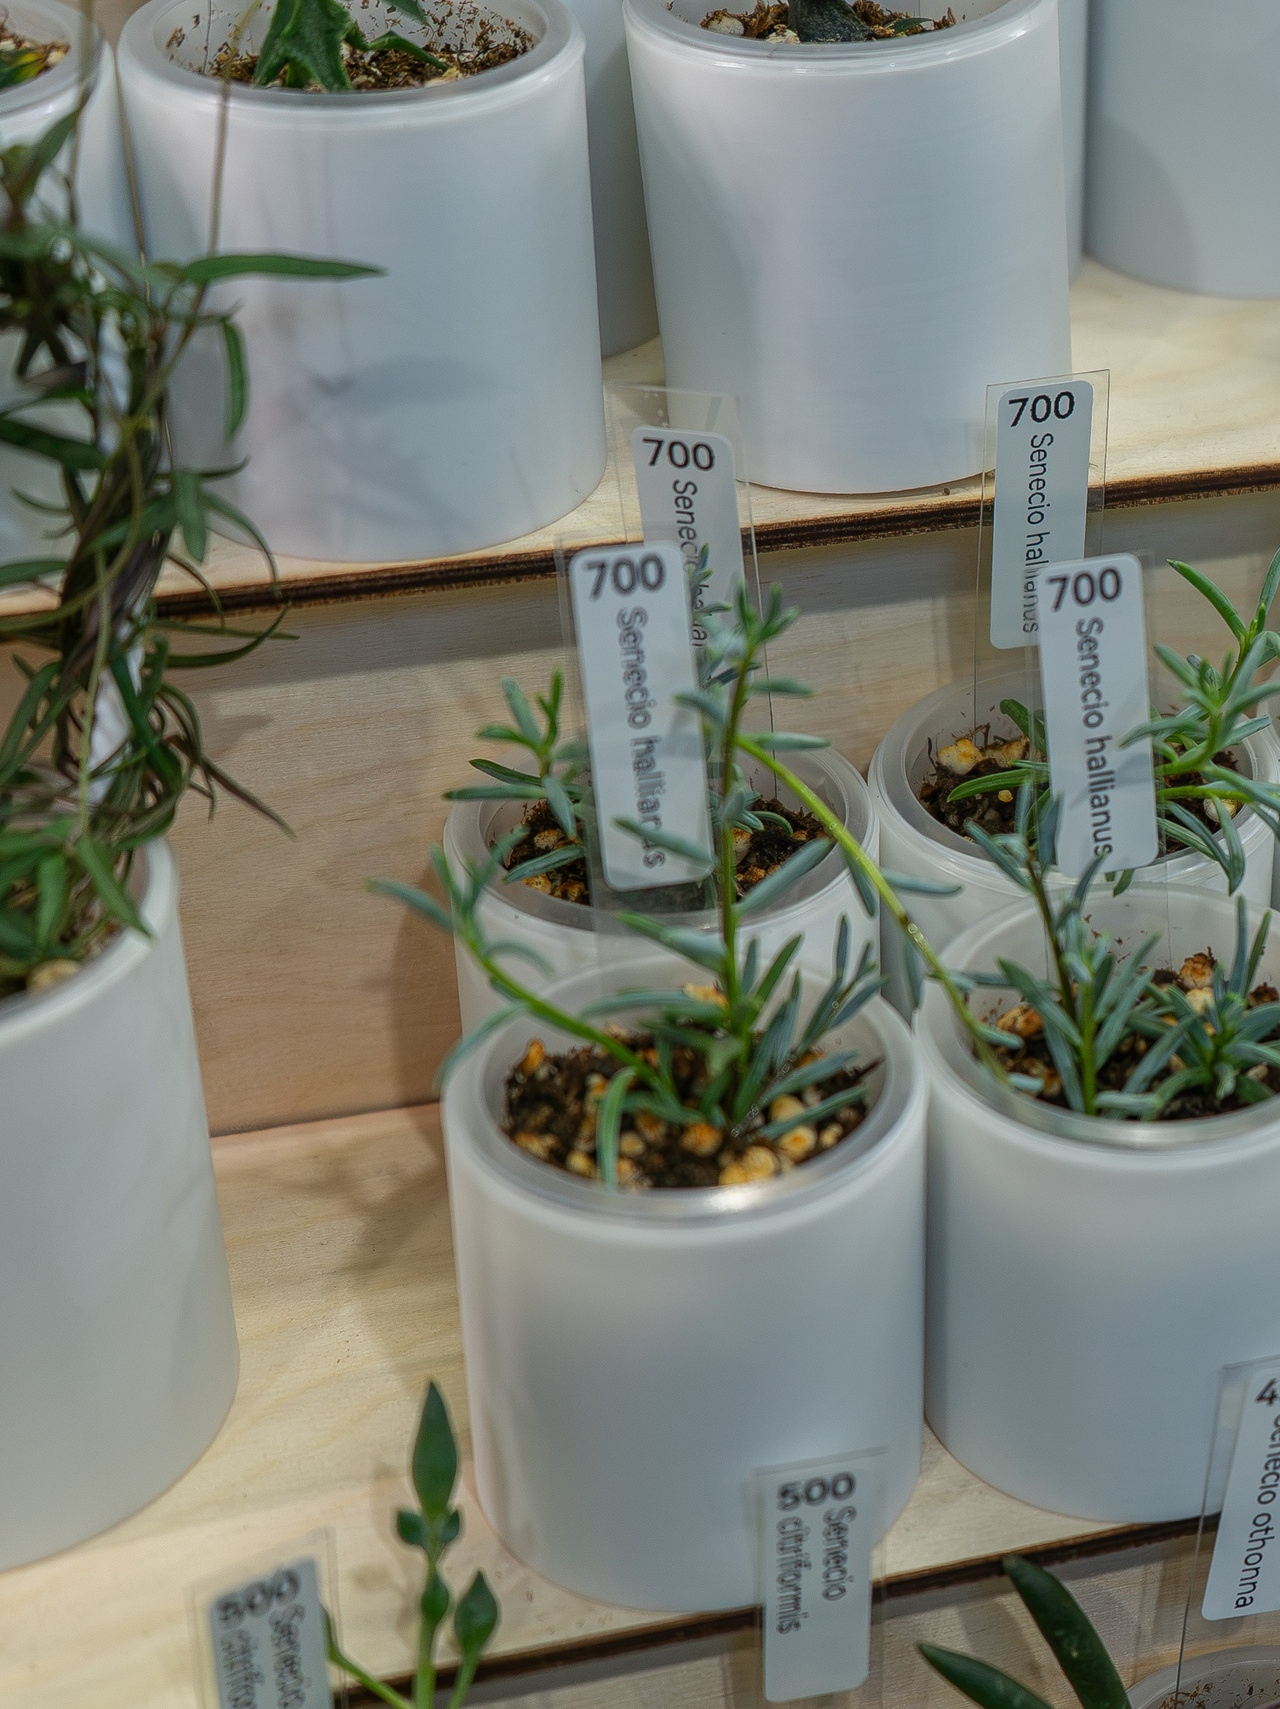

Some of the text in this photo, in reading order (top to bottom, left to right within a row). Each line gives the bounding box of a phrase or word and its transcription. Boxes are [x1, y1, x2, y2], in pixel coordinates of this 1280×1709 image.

[1009, 391, 1075, 427] 700
[642, 436, 715, 471] 700
[1027, 433, 1054, 525] Senecio
[585, 554, 665, 600] 700
[1047, 566, 1122, 612] 700
[616, 606, 666, 869] Senecio hallians
[1076, 617, 1116, 857] Senecio hallianus
[778, 1471, 856, 1511] 500
[822, 1505, 857, 1601] Senecio
[1234, 1512, 1275, 1609] othonna
